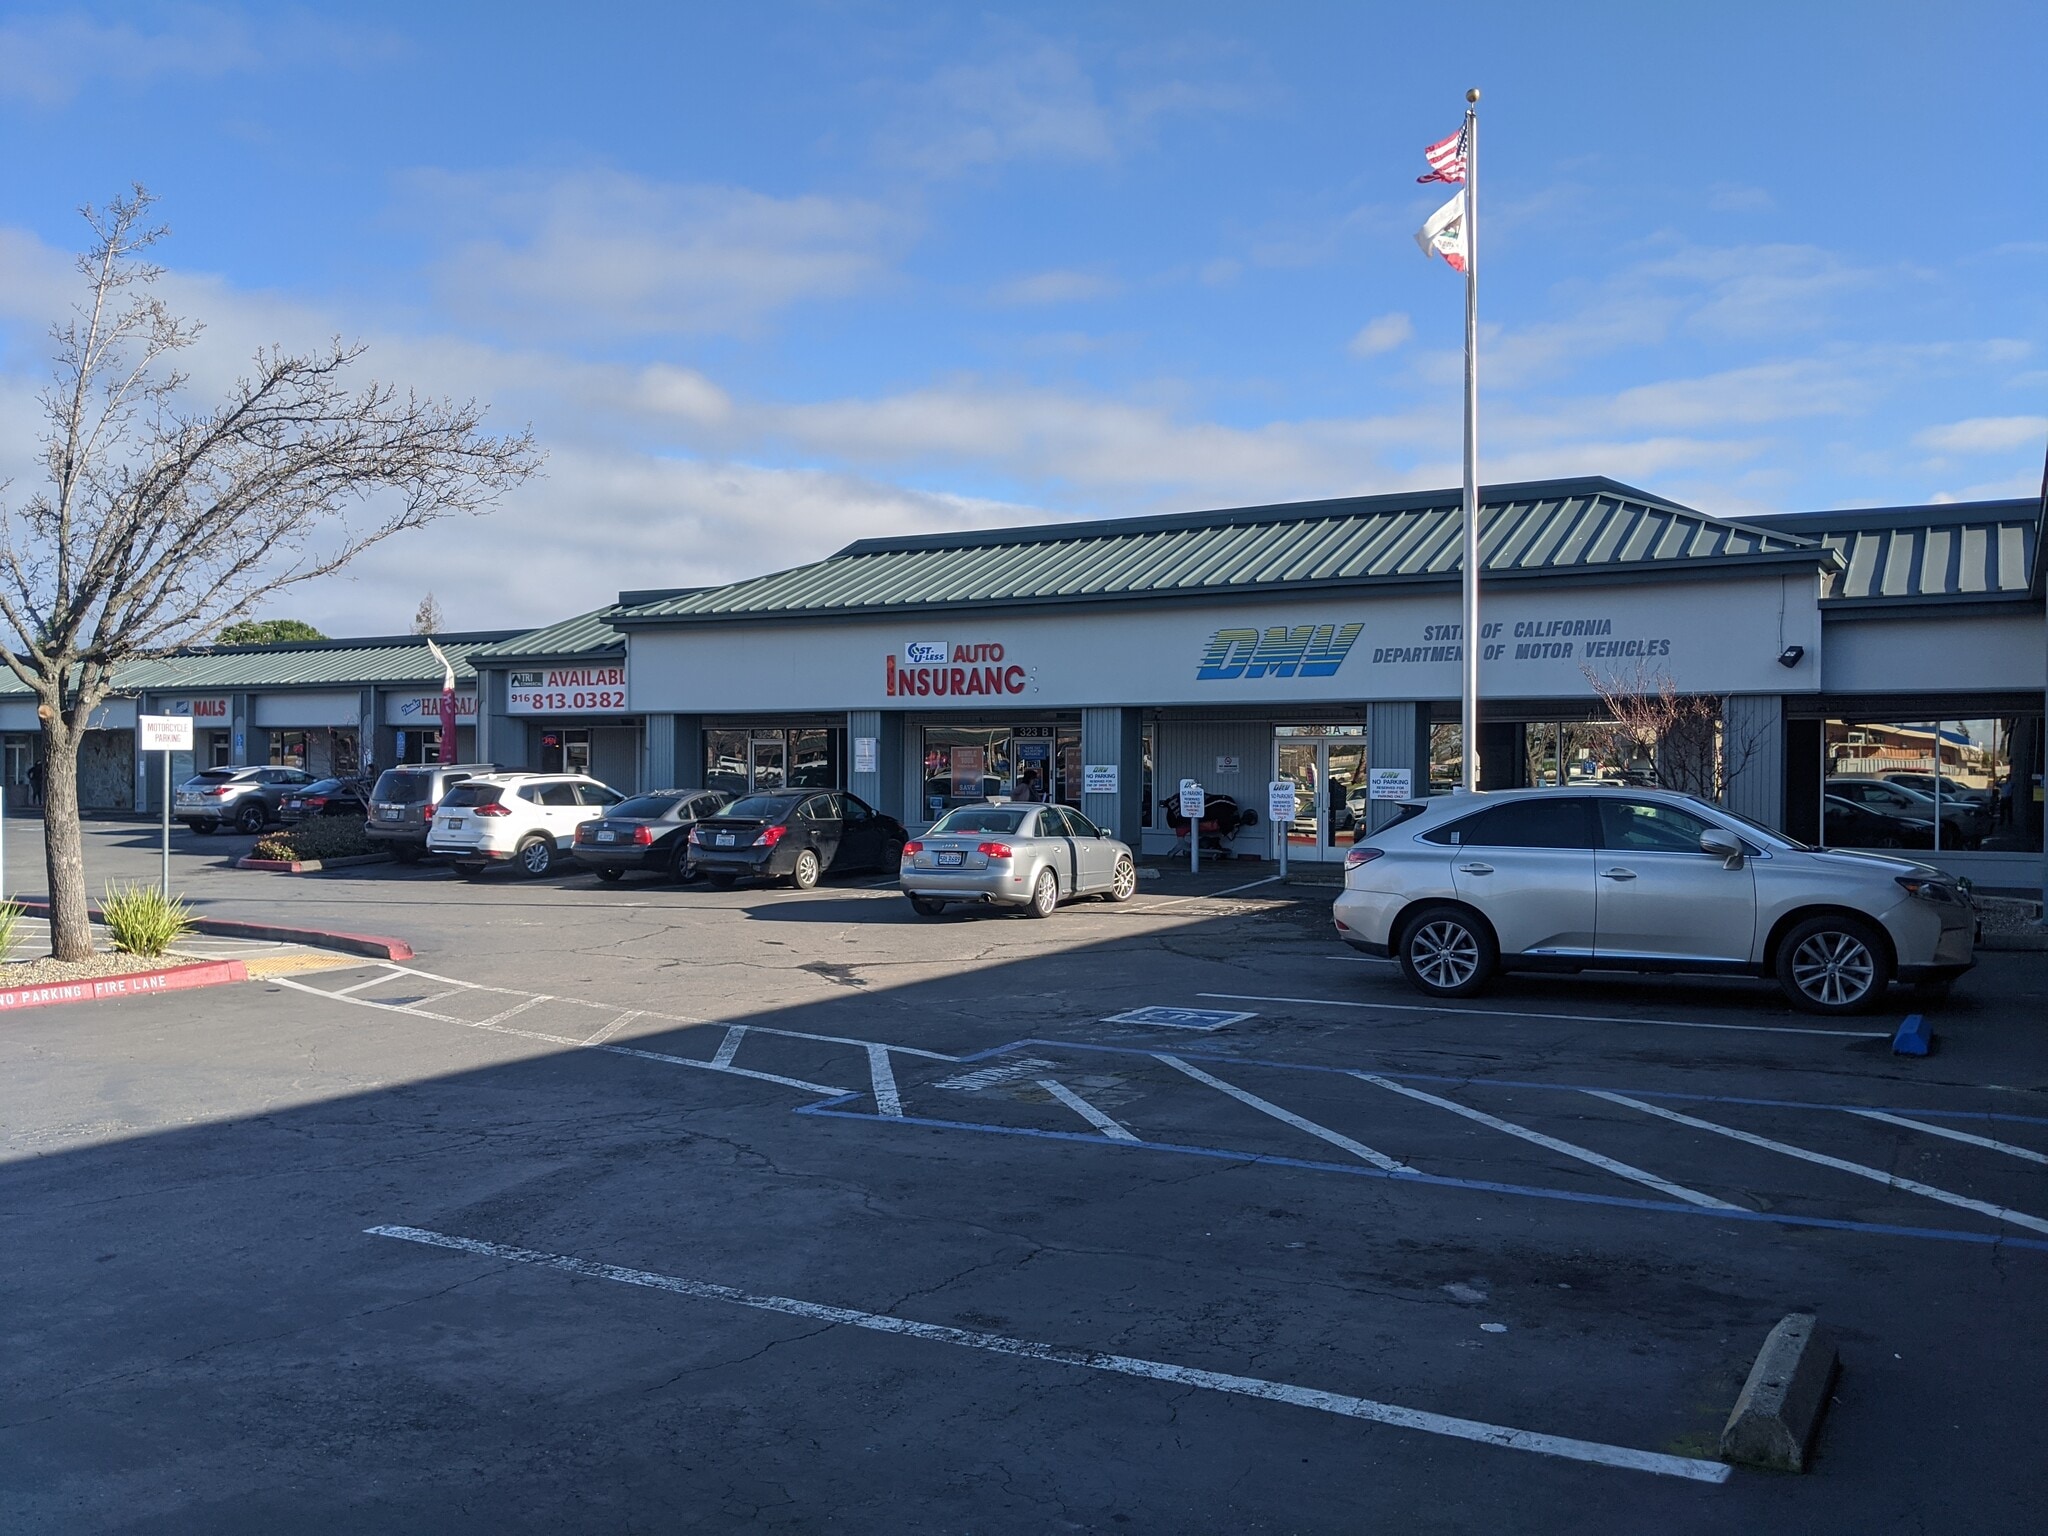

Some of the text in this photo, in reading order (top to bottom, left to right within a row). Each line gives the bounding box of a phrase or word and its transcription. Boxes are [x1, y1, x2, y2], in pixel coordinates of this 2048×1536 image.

[1424, 619, 1612, 641] STAT OF CALIFORNIA
[953, 643, 1005, 663] AUTO
[1196, 623, 1366, 680] DMV
[1373, 639, 1671, 664] DEPARTMEN OF MOTOR VEHICLES
[520, 673, 533, 682] TRI
[887, 655, 1026, 696] INSURANC
[194, 700, 226, 716] NAILS
[511, 691, 625, 710] 916 813.0382
[147, 723, 188, 732] MOTORCYCLE
[1020, 728, 1049, 736] 323 B
[155, 734, 181, 742] PARKING
[21, 986, 82, 1004] PARKING
[96, 980, 126, 994] FIRE
[133, 975, 168, 991] LANE
